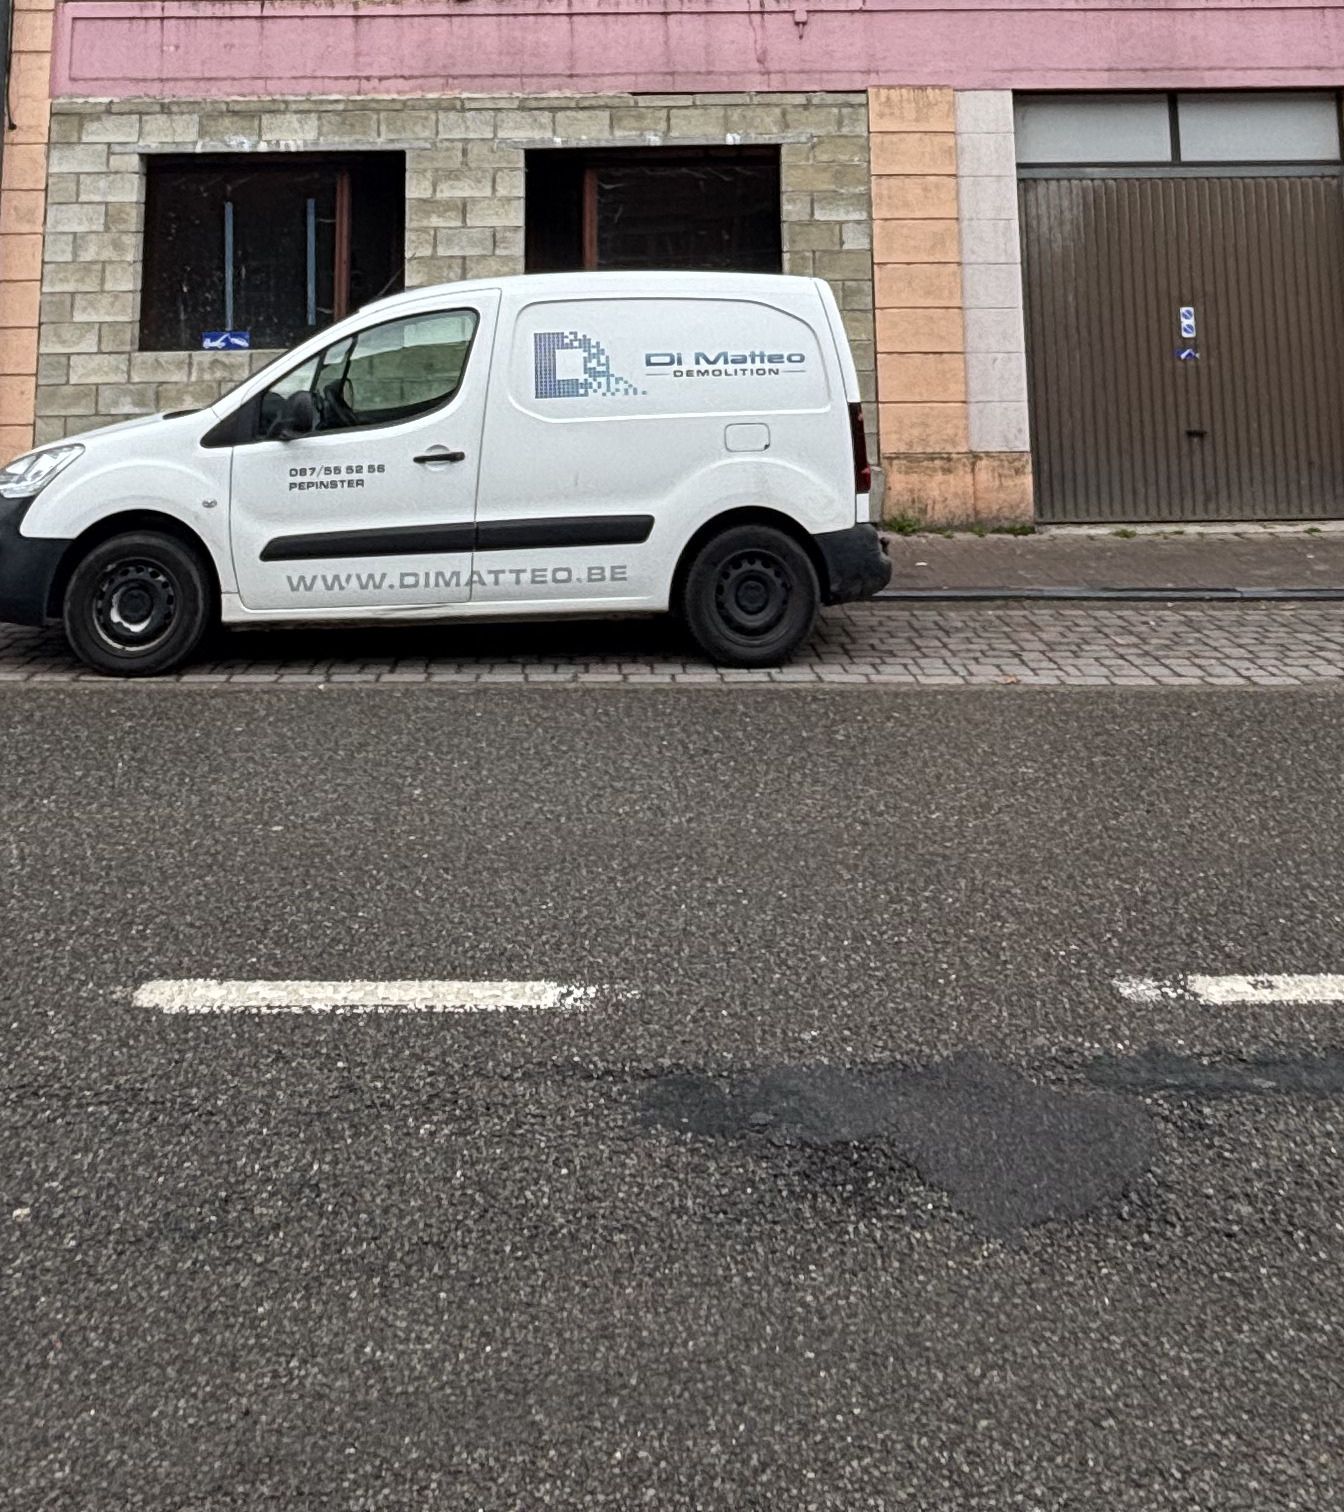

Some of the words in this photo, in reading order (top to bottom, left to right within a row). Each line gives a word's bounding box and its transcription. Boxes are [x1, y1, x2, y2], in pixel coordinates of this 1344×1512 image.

[645, 352, 683, 366] Di
[694, 351, 805, 365] Matteo
[673, 368, 779, 378] DEMOLITION
[289, 479, 364, 490] PEPINSTER
[286, 565, 627, 592] WWW.DIMATTEO.BE
